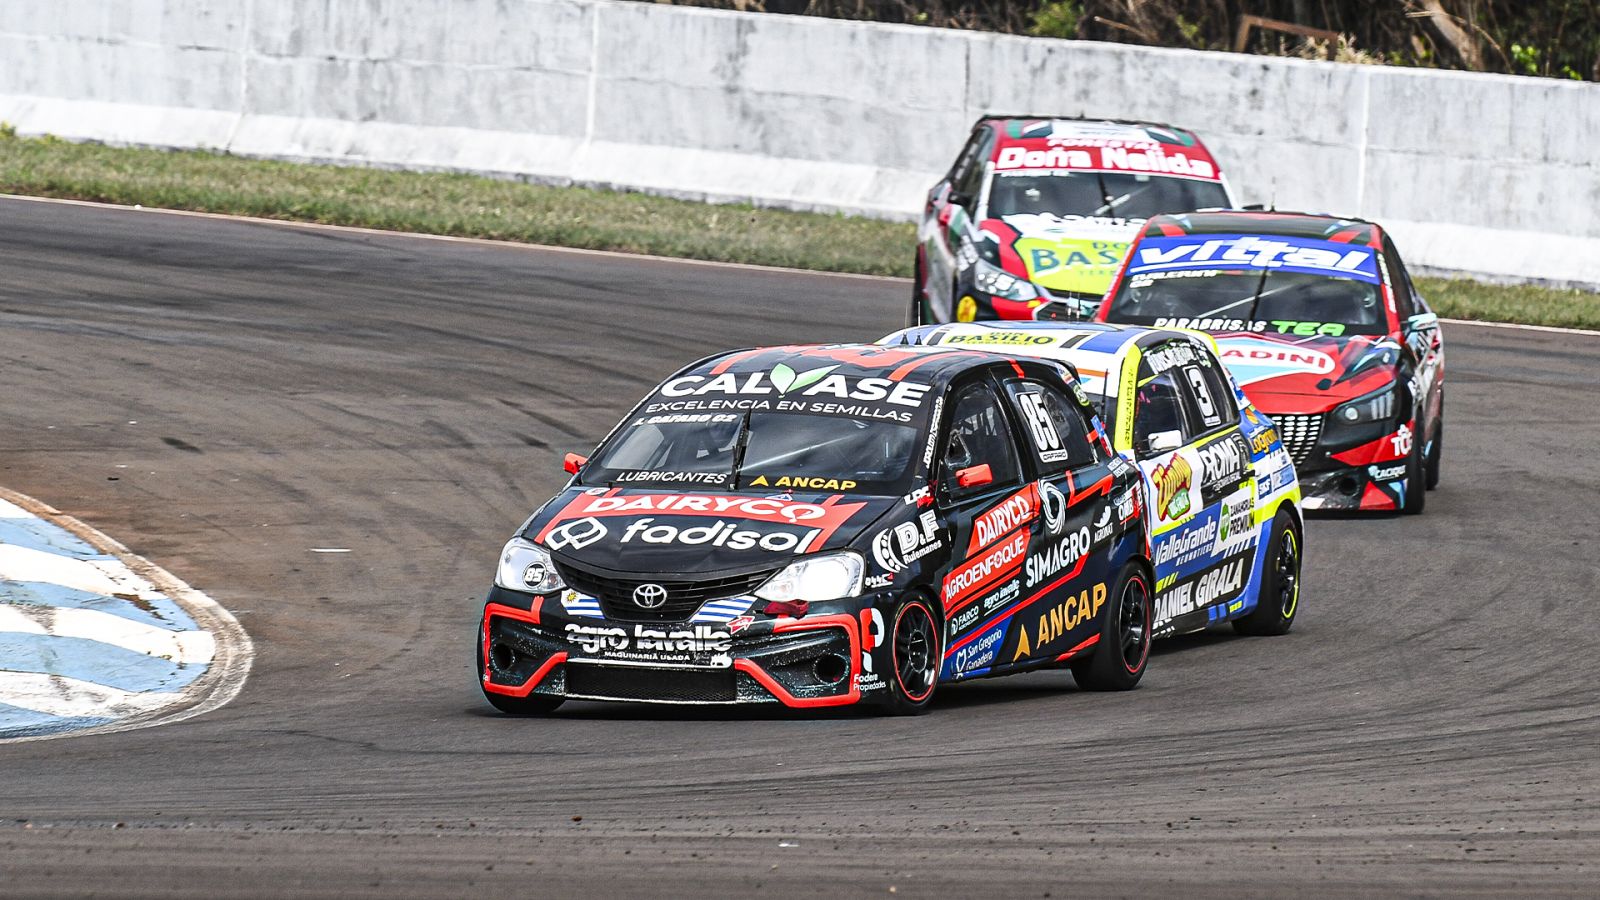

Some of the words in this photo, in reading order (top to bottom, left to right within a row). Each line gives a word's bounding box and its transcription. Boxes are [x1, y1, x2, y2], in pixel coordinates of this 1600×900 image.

[996, 147, 1092, 169] Doña
[1031, 248, 1119, 273] BAS
[1140, 237, 1375, 274] vittal
[947, 335, 1054, 345] BASILIO
[1271, 320, 1346, 337] TEA
[1221, 349, 1326, 369] ADINI
[1188, 368, 1214, 417] 3
[645, 399, 770, 414] EXCELENCIA
[776, 400, 806, 412] EN
[810, 402, 913, 423] SEMILLAS
[1020, 394, 1059, 450] 85
[616, 470, 728, 484] LUBRICANTES
[775, 476, 858, 490] ANCAP
[582, 494, 829, 525] DAIRYCO
[976, 495, 1031, 548] DAIRYCO
[620, 518, 819, 554] fadisol
[1026, 530, 1091, 589] SIMAGRO
[523, 566, 544, 582] 85
[945, 546, 1025, 604] AGROENFOQUE
[1195, 557, 1248, 608] GIRALA
[958, 605, 980, 626] FARCO
[1036, 583, 1108, 651] ANCAP
[564, 623, 629, 654] agro
[634, 623, 732, 652] lavalle
[978, 628, 1002, 650] Gregorio
[604, 651, 659, 664] MAQUINARIA
[853, 681, 887, 692] Propiedades
